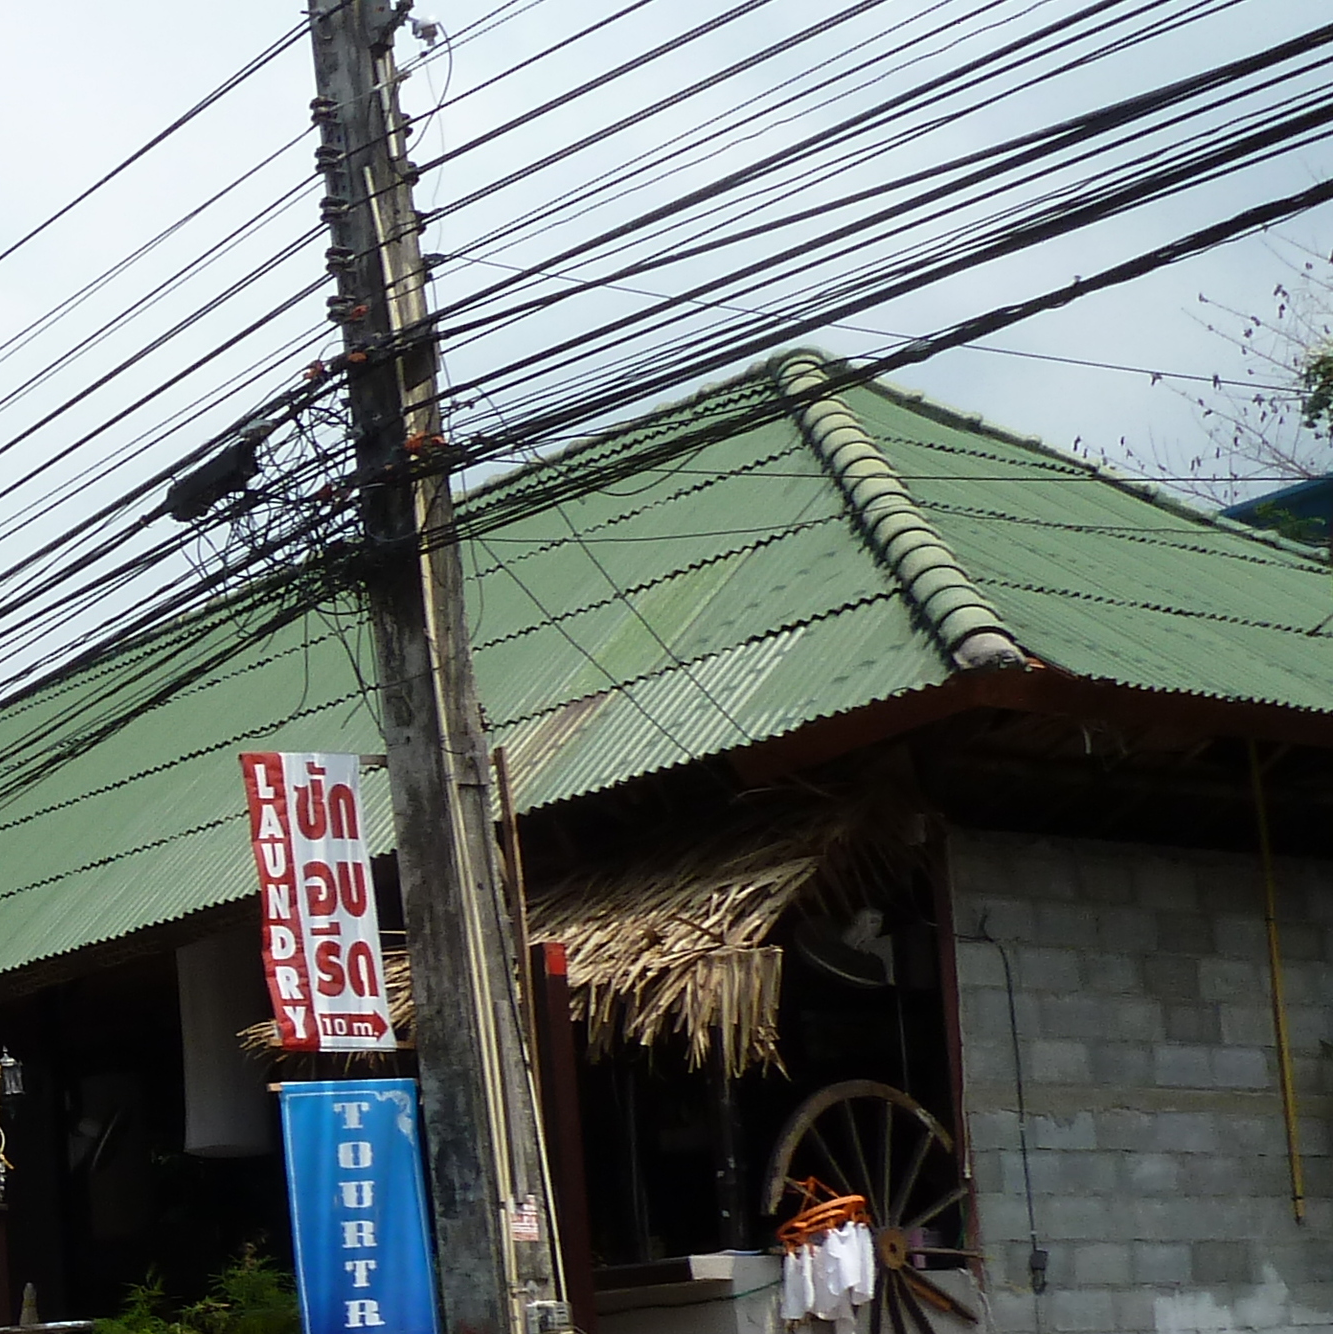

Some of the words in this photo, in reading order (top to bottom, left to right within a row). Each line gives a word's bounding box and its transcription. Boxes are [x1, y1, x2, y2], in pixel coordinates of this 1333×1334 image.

[293, 761, 359, 840] ซัก
[254, 763, 308, 1039] LAUNDRY
[303, 860, 367, 918] อบ
[310, 921, 379, 998] รีด
[323, 1016, 347, 1035] 10
